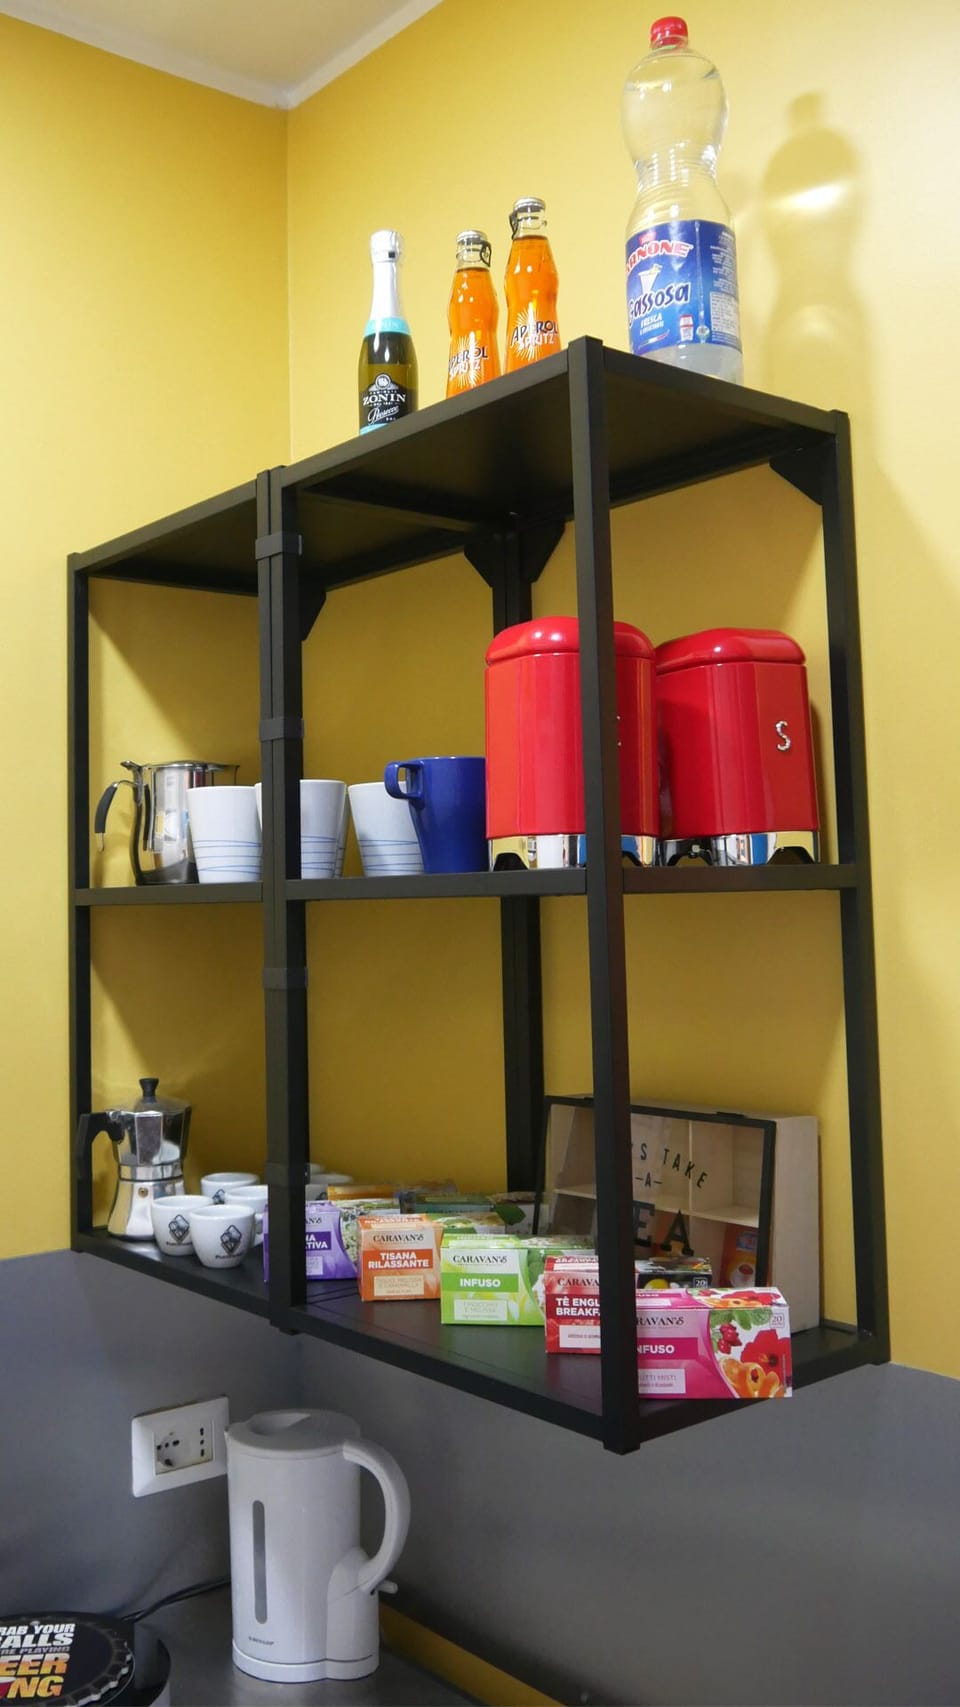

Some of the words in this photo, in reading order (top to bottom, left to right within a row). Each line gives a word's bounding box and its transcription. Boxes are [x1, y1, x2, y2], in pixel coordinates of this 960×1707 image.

[510, 320, 558, 348] APROL
[362, 393, 406, 406] ZONIN
[775, 720, 791, 751] S
[663, 1148, 709, 1189] TAKE
[632, 1200, 695, 1257] EA
[305, 1241, 328, 1249] TIVA
[380, 1252, 417, 1260] TISANA
[368, 1259, 429, 1269] RILASSANTE
[460, 1278, 501, 1288] INFUSO
[558, 1278, 600, 1287] CARAVA
[572, 1298, 600, 1307] ENGL
[556, 1308, 600, 1317] BREAKF
[637, 1316, 685, 1326] RAVAN'S
[637, 1344, 675, 1354] NFUSO
[34, 1623, 76, 1635] YOUR
[0, 1633, 74, 1649] ALLS
[20, 1646, 71, 1654] PLAYING
[0, 1652, 71, 1676] EER
[7, 1675, 65, 1699] NG
